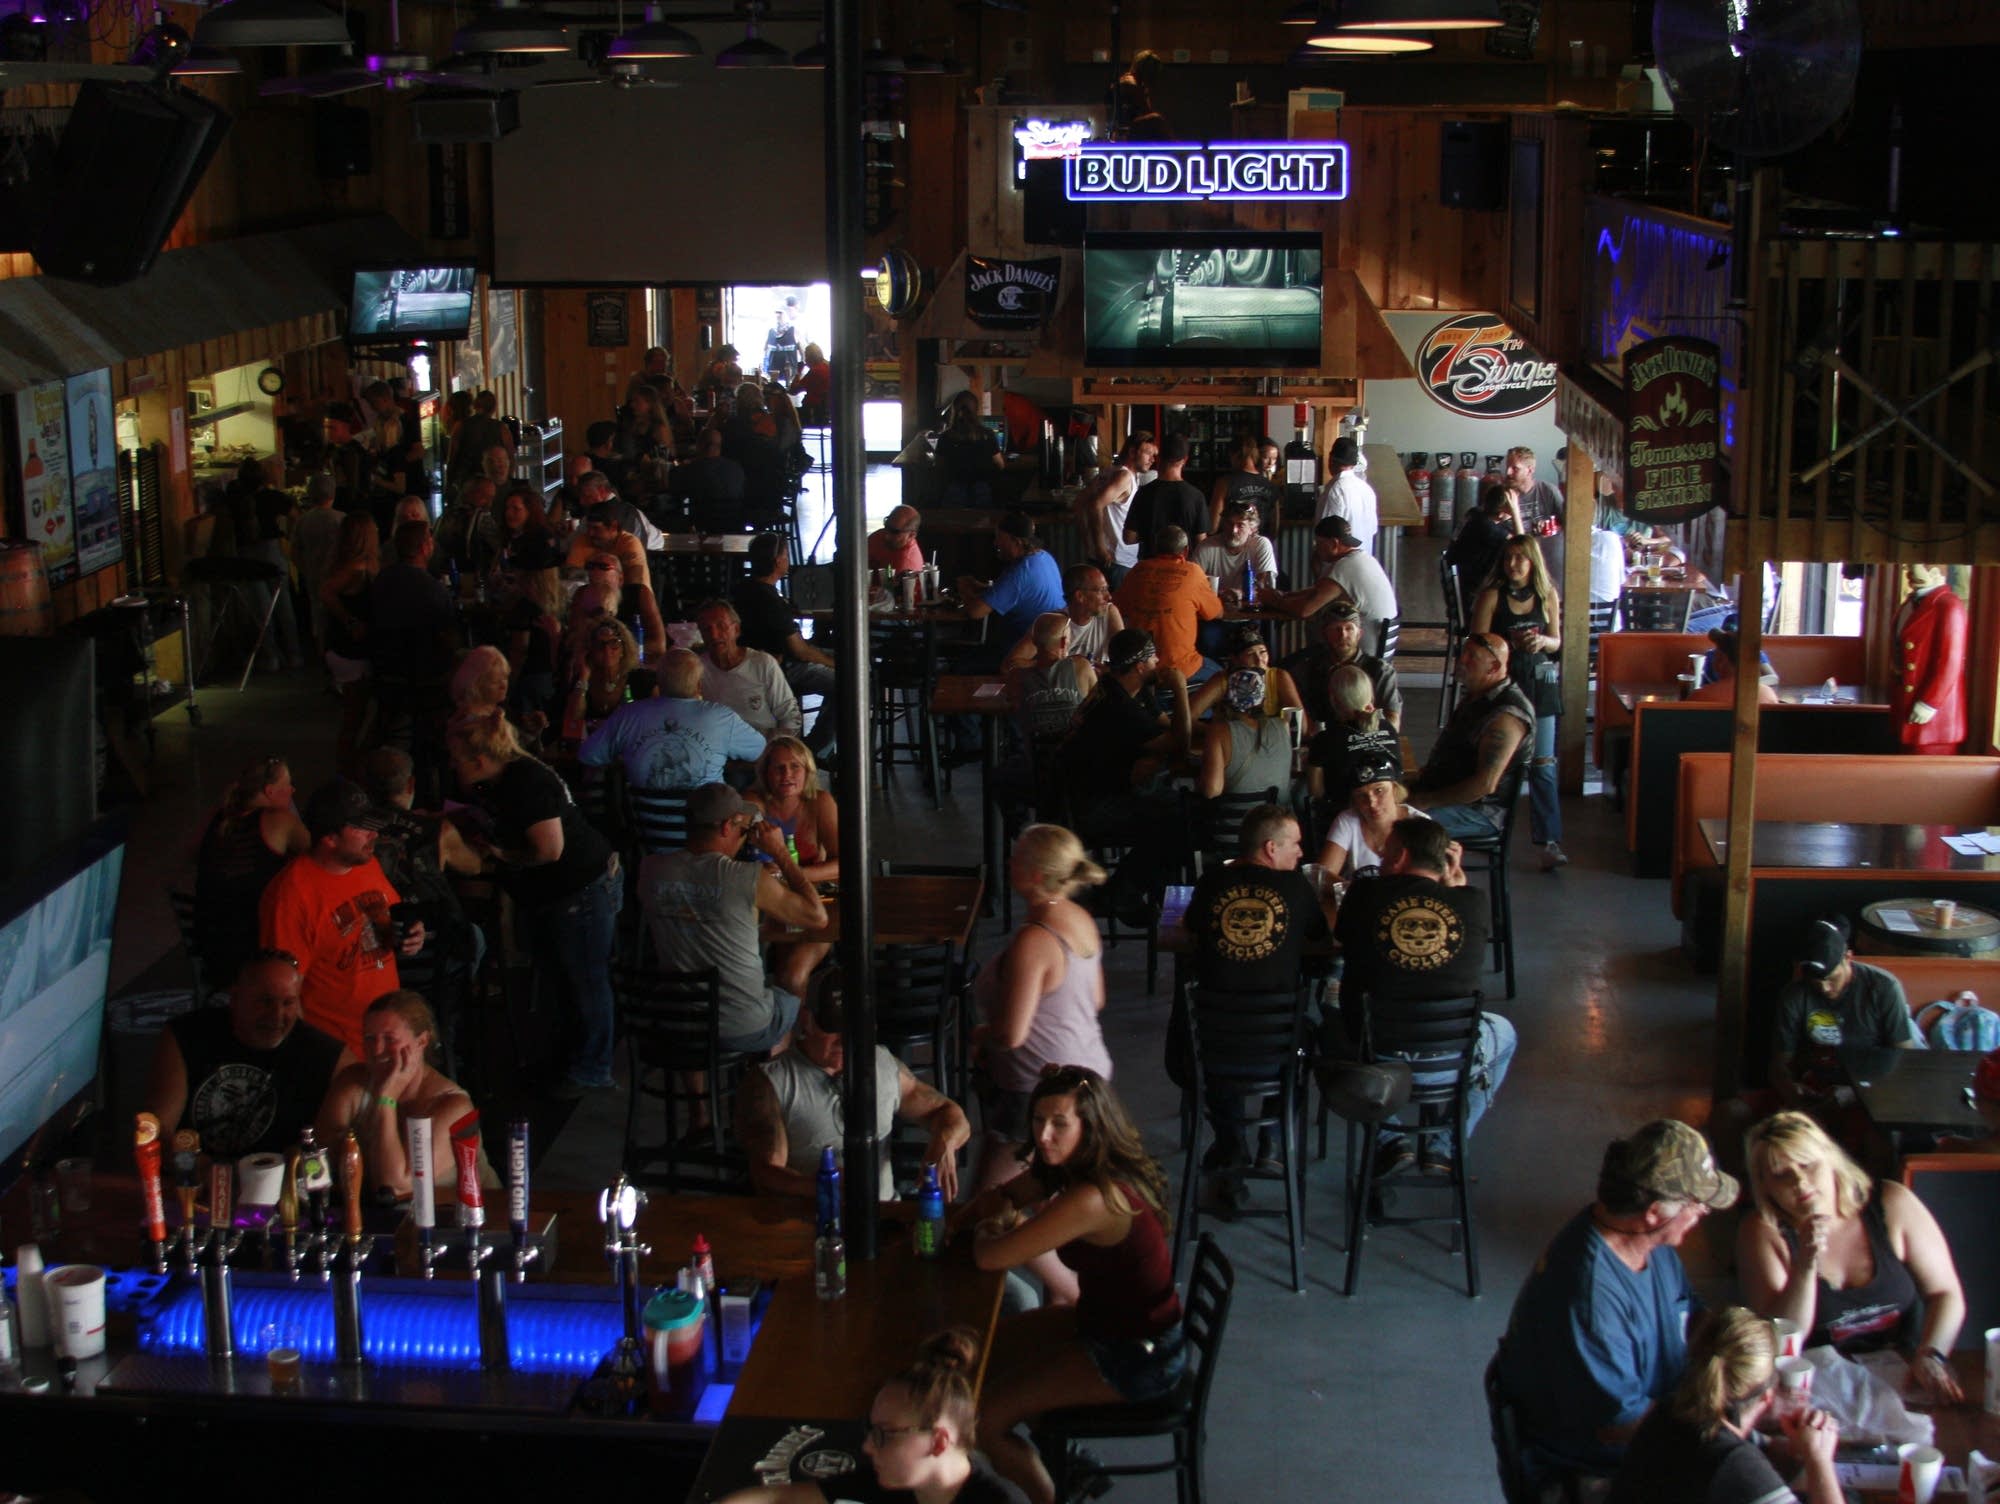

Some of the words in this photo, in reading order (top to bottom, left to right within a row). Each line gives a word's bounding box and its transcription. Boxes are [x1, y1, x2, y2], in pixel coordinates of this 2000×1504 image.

[1075, 154, 1182, 193] BUD
[1186, 153, 1336, 194] LIGHT
[969, 268, 1004, 292] JACK
[1004, 263, 1057, 293] DANIEL'S
[1629, 351, 1665, 392] JACK
[1471, 380, 1526, 393] MOTORCYCLE
[1629, 440, 1716, 468] Tennessee
[1644, 464, 1702, 490] FIRE
[1634, 482, 1713, 511] STATION
[1211, 886, 1250, 914] GAME
[1253, 886, 1285, 913] OVER
[1379, 896, 1420, 926] GAME
[1423, 897, 1457, 926] OVER
[1216, 938, 1274, 960] CYCLES
[1387, 947, 1450, 967] CYCLES
[513, 1137, 528, 1187] LIGHT
[511, 1188, 526, 1221] BUD
